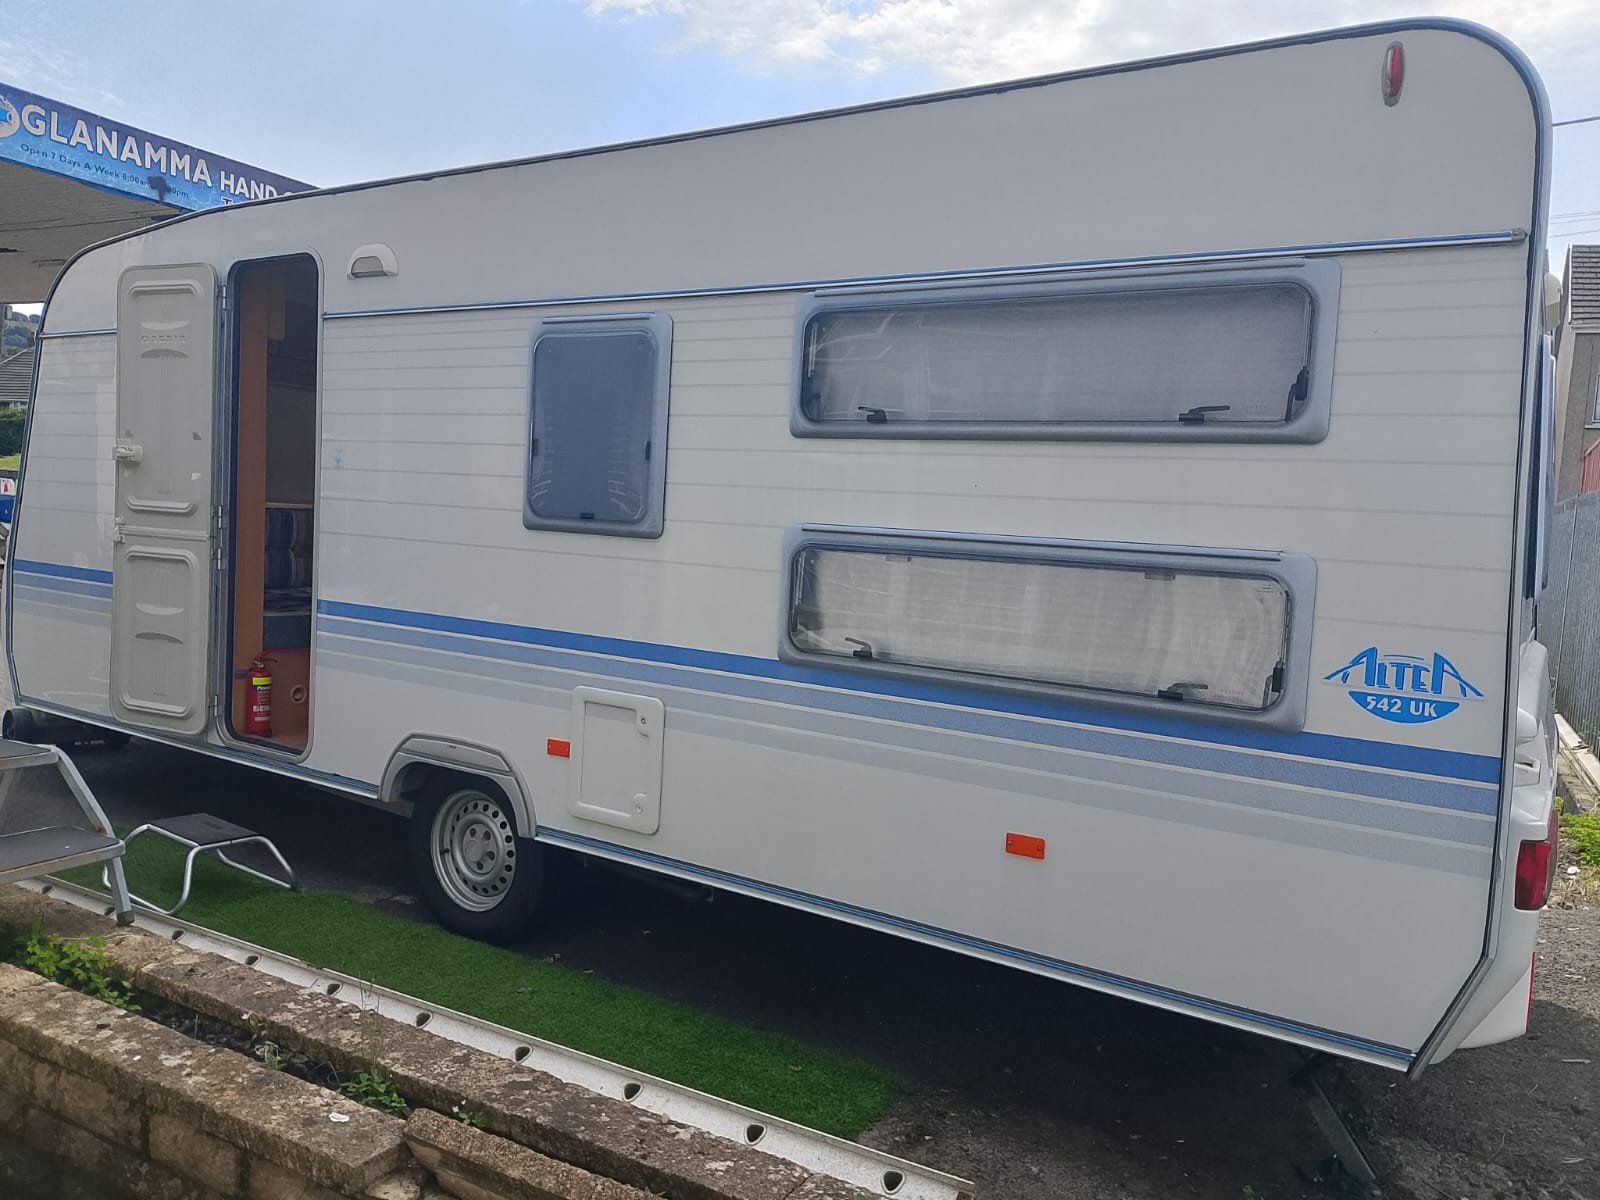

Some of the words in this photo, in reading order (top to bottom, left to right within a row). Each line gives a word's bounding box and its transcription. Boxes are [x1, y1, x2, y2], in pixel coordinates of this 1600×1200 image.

[20, 143, 48, 158] Open
[50, 152, 56, 160] 7
[59, 154, 81, 169] Days
[84, 162, 92, 170] A
[94, 164, 120, 179] Week
[21, 104, 212, 187] GLANAMMA
[1366, 695, 1402, 714] 542
[1409, 702, 1437, 718] UK
